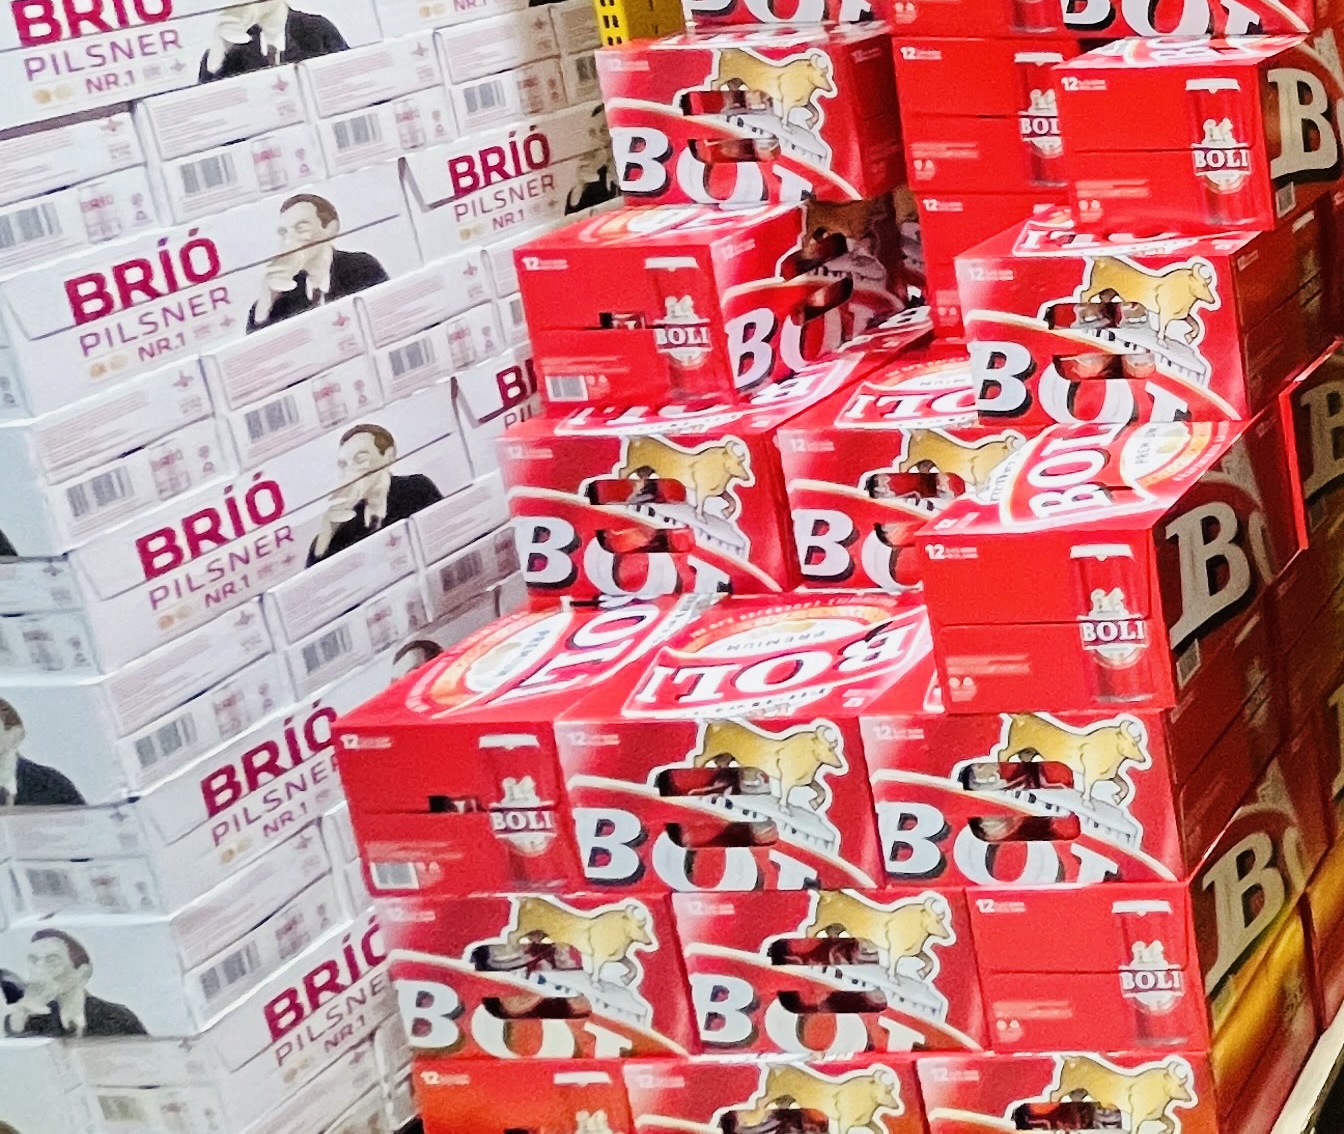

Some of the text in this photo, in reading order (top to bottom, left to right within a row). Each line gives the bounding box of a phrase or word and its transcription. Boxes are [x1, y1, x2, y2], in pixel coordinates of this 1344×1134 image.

[23, 28, 183, 82] PILSNER
[1019, 116, 1061, 136] BOL
[447, 124, 552, 200] BRÍÓ
[1193, 146, 1250, 168] BOLI
[453, 173, 556, 223] PILSNER
[64, 227, 221, 326] BRÍÓ
[79, 284, 232, 359] PILSNER
[655, 325, 709, 349] BOLI
[134, 471, 287, 582] BRÍÓ
[925, 544, 944, 559] 12
[148, 524, 295, 612] PILSNER
[1080, 620, 1147, 641] BOLI
[200, 697, 338, 820] BRÍÓ
[490, 811, 554, 833] BOLI
[1121, 970, 1181, 991] BOLI
[274, 974, 392, 1067] PILSNE
